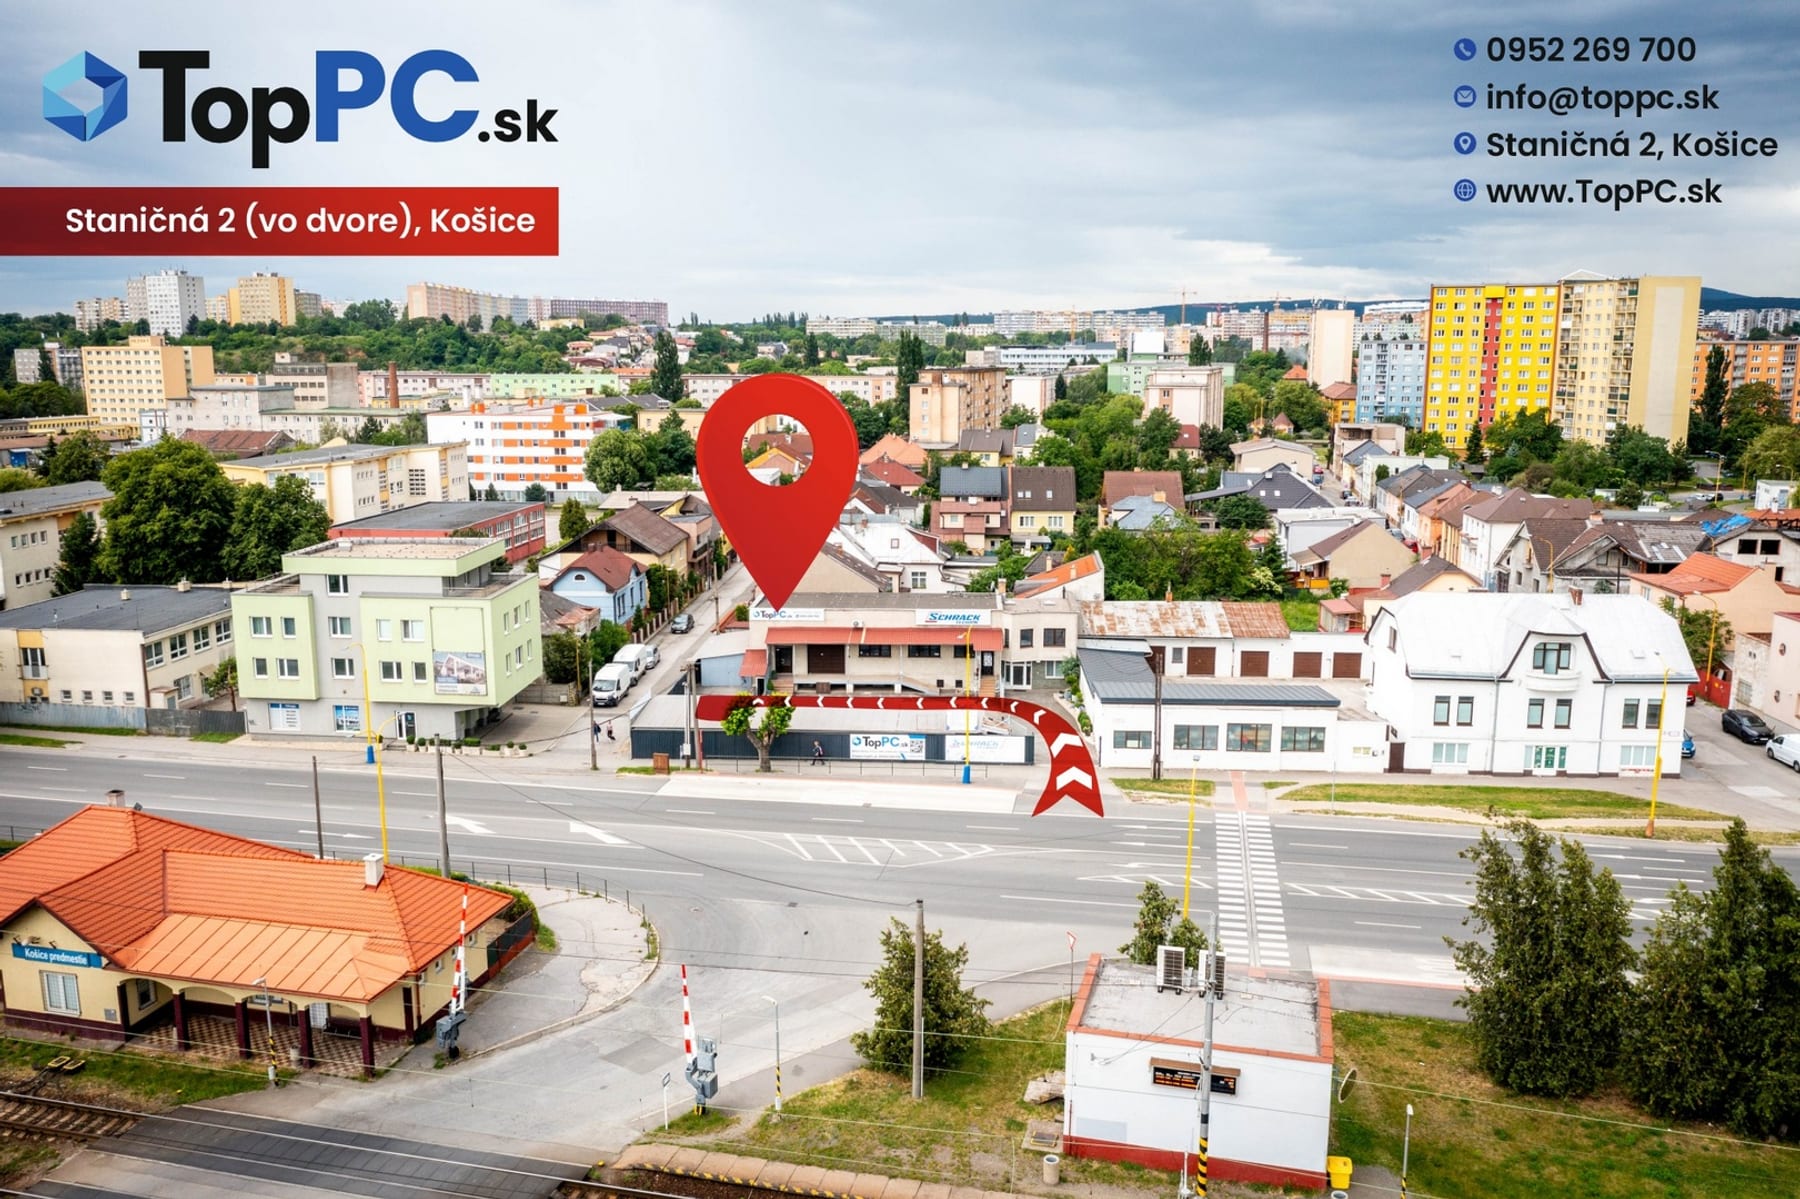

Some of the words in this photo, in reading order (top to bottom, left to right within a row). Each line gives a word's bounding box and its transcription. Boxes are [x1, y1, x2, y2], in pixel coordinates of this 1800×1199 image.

[929, 612, 981, 621] SCHRACK
[25, 947, 49, 960] Košice
[49, 952, 88, 965] predmestie
